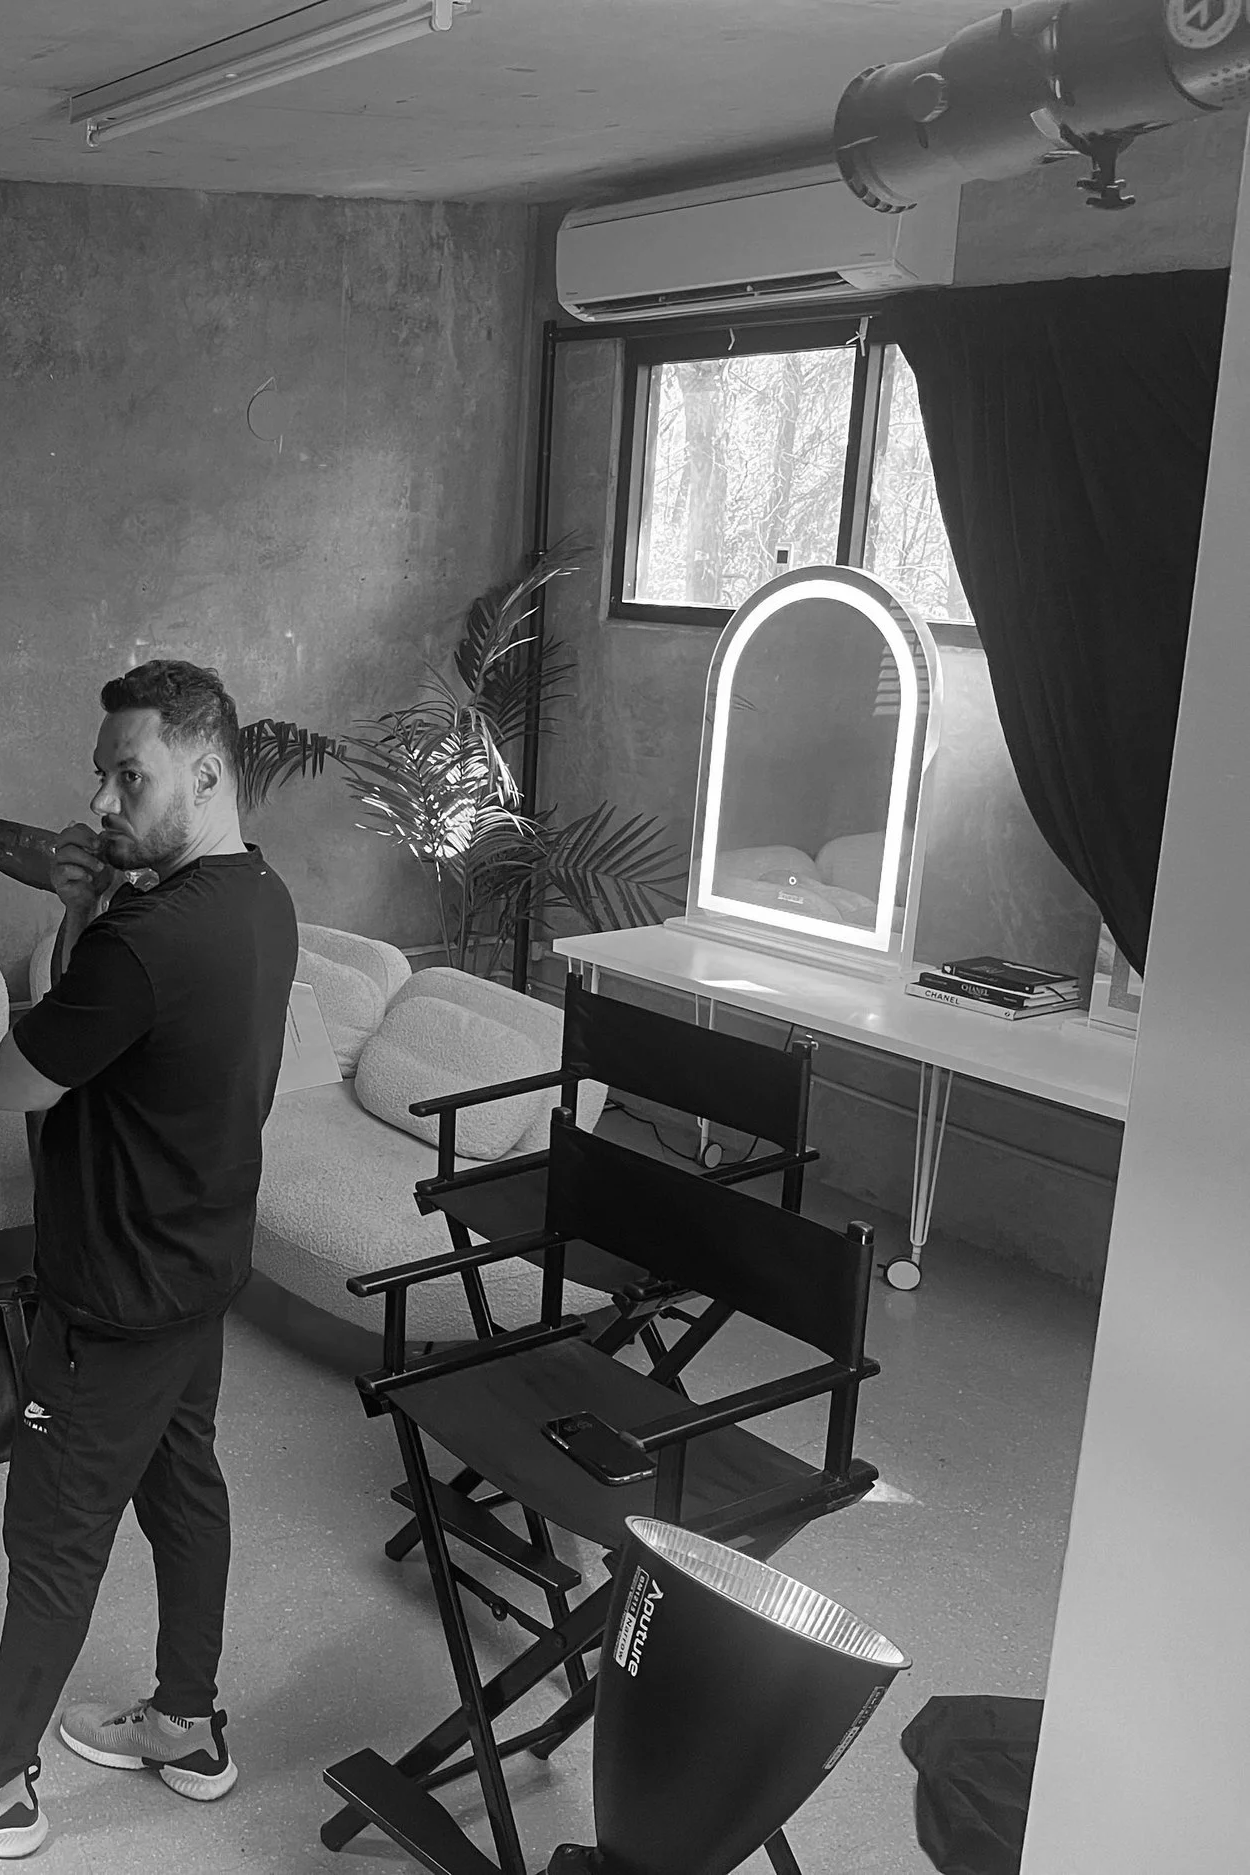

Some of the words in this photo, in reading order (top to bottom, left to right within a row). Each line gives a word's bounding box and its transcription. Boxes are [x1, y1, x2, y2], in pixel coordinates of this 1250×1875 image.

[925, 990, 960, 1005] CHANEL
[618, 1617, 633, 1661] Narrow
[627, 1579, 664, 1677] Aputure
